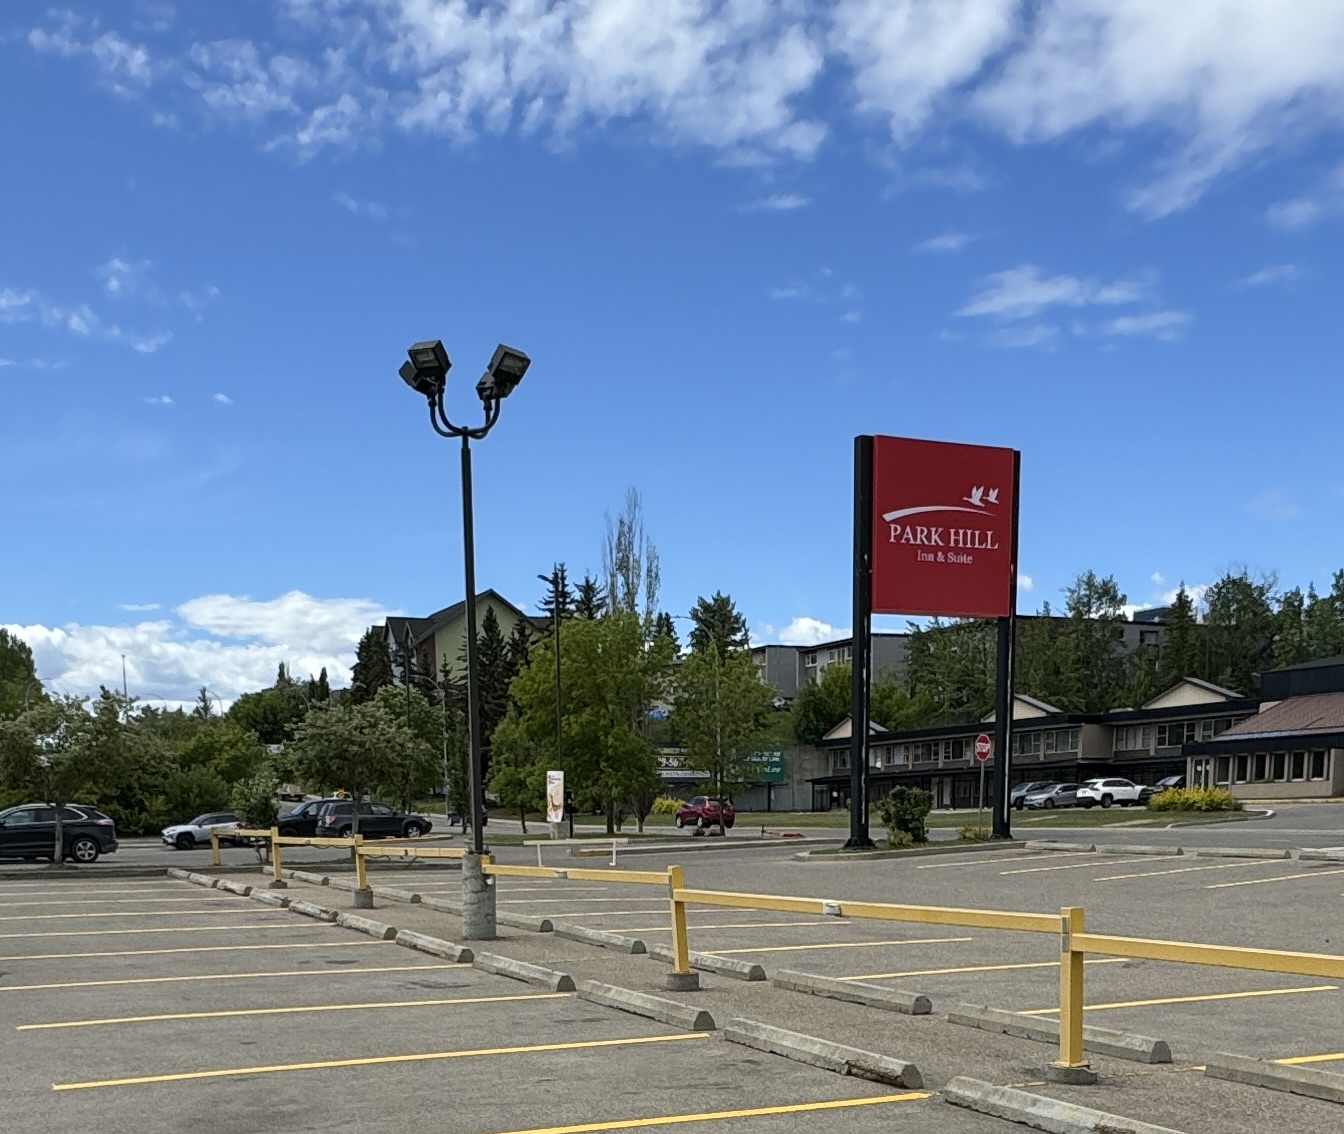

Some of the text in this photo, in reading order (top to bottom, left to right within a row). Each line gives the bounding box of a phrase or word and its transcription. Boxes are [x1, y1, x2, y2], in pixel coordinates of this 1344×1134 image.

[889, 523, 999, 550] PARK HILL
[917, 550, 974, 565] Inn & Suite
